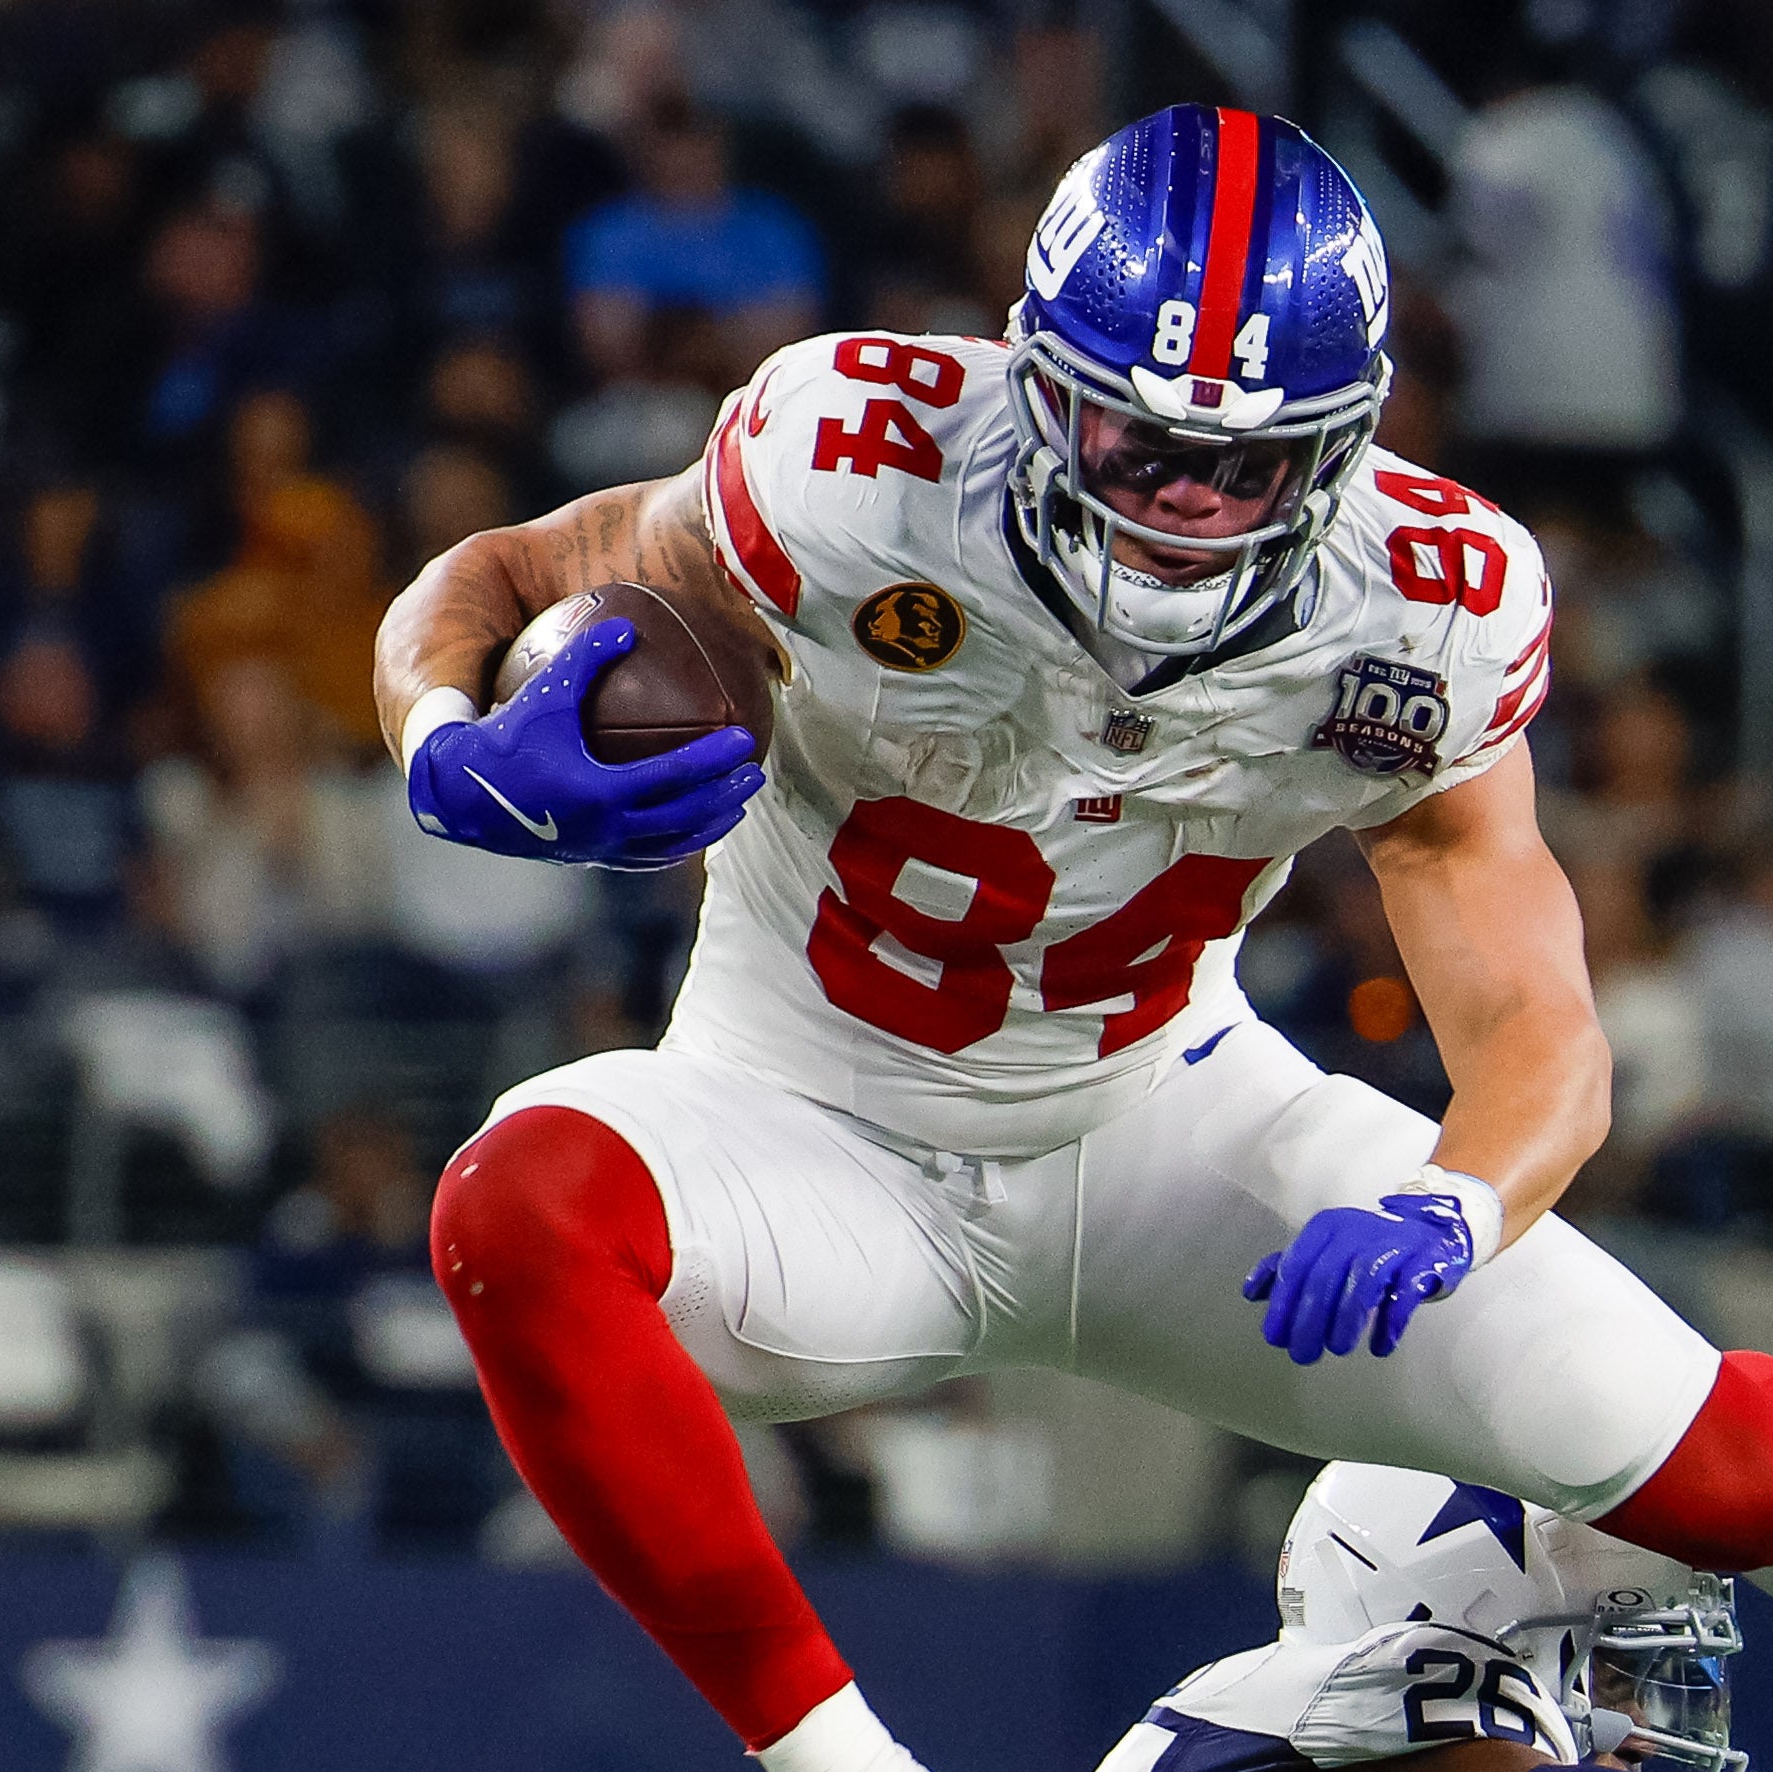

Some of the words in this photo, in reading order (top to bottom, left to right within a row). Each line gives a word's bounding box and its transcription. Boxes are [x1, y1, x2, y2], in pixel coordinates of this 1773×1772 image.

[1152, 300, 1272, 380] 84
[811, 337, 967, 484] 84
[1373, 469, 1509, 618] 84
[1108, 727, 1141, 749] NFL
[1335, 673, 1445, 742] 100
[1335, 722, 1424, 754] SEASONS
[806, 796, 1275, 1060] 84
[1403, 1648, 1542, 1747] 26
